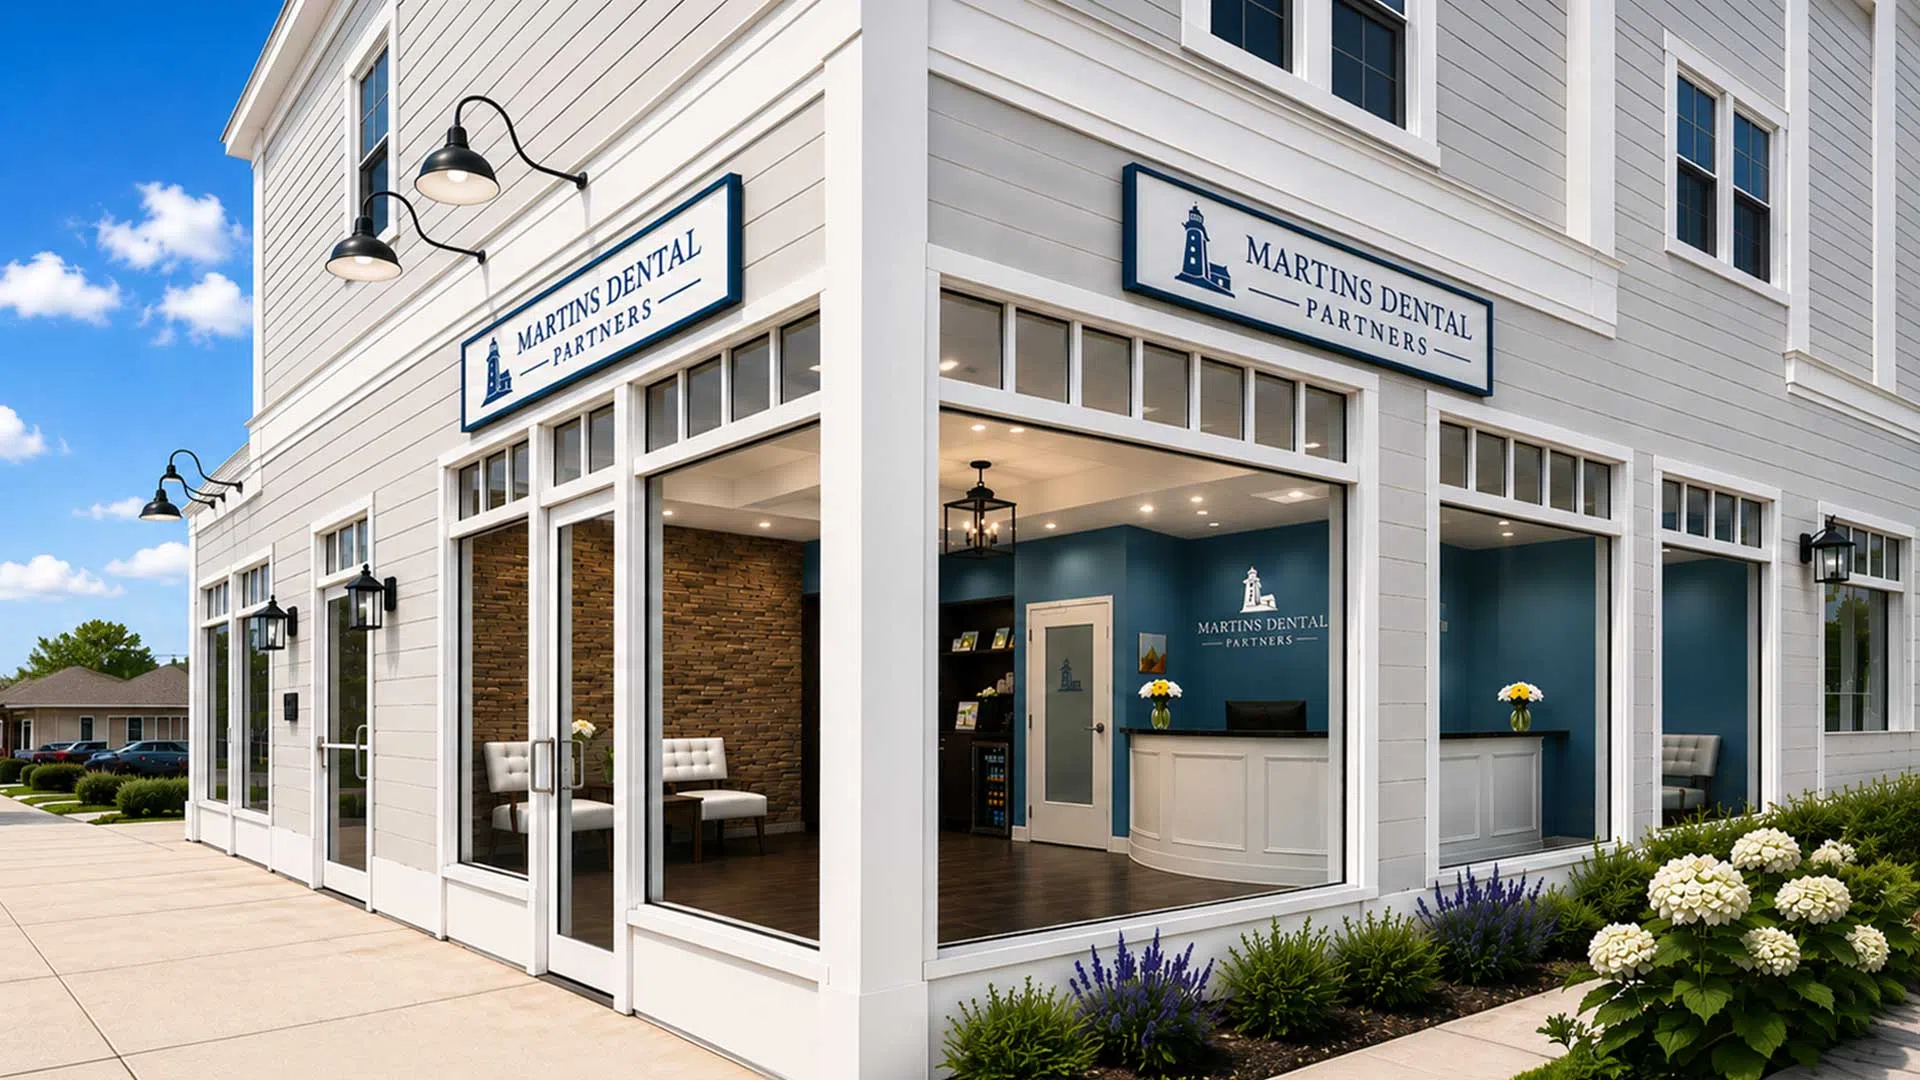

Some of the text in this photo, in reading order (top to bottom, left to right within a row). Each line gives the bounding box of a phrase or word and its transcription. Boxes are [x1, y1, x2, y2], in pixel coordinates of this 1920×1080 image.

[516, 228, 702, 356] MARTINS DENTAL
[1246, 235, 1473, 341] MARTINS DENTAL
[552, 298, 653, 367] PARTNERS
[1306, 297, 1428, 356] PARTNERS
[1198, 615, 1328, 634] MARTINS DENTAL
[1226, 635, 1292, 648] PARTNERS
